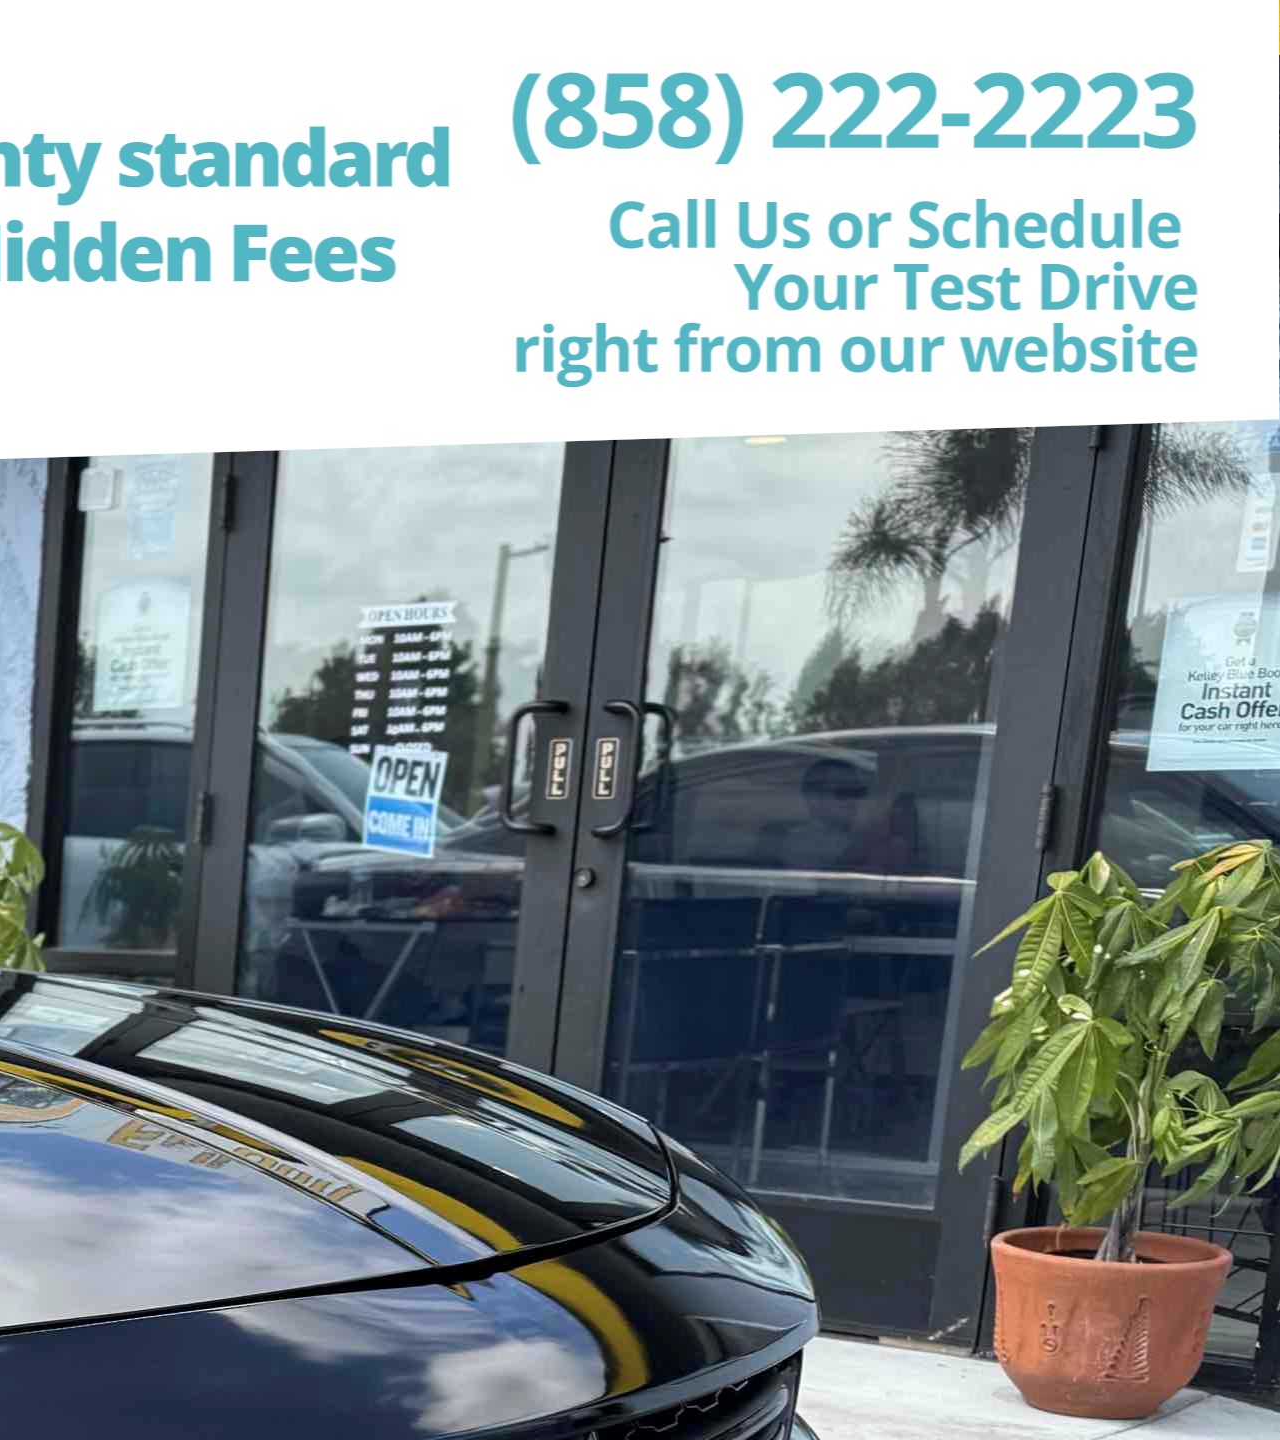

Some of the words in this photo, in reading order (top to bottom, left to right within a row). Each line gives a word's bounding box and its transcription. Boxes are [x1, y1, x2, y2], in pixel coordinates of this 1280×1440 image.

[368, 609, 401, 622] OPEN
[405, 607, 447, 621] HOURS
[1225, 656, 1246, 667] Get
[1258, 668, 1280, 679] Boo
[1202, 682, 1272, 700] Instant
[1181, 702, 1230, 720] Cash
[373, 756, 441, 799] OPEN
[551, 743, 567, 795] PULL
[598, 742, 614, 795] PULL
[368, 810, 414, 837] COME
[414, 816, 431, 841] IN
